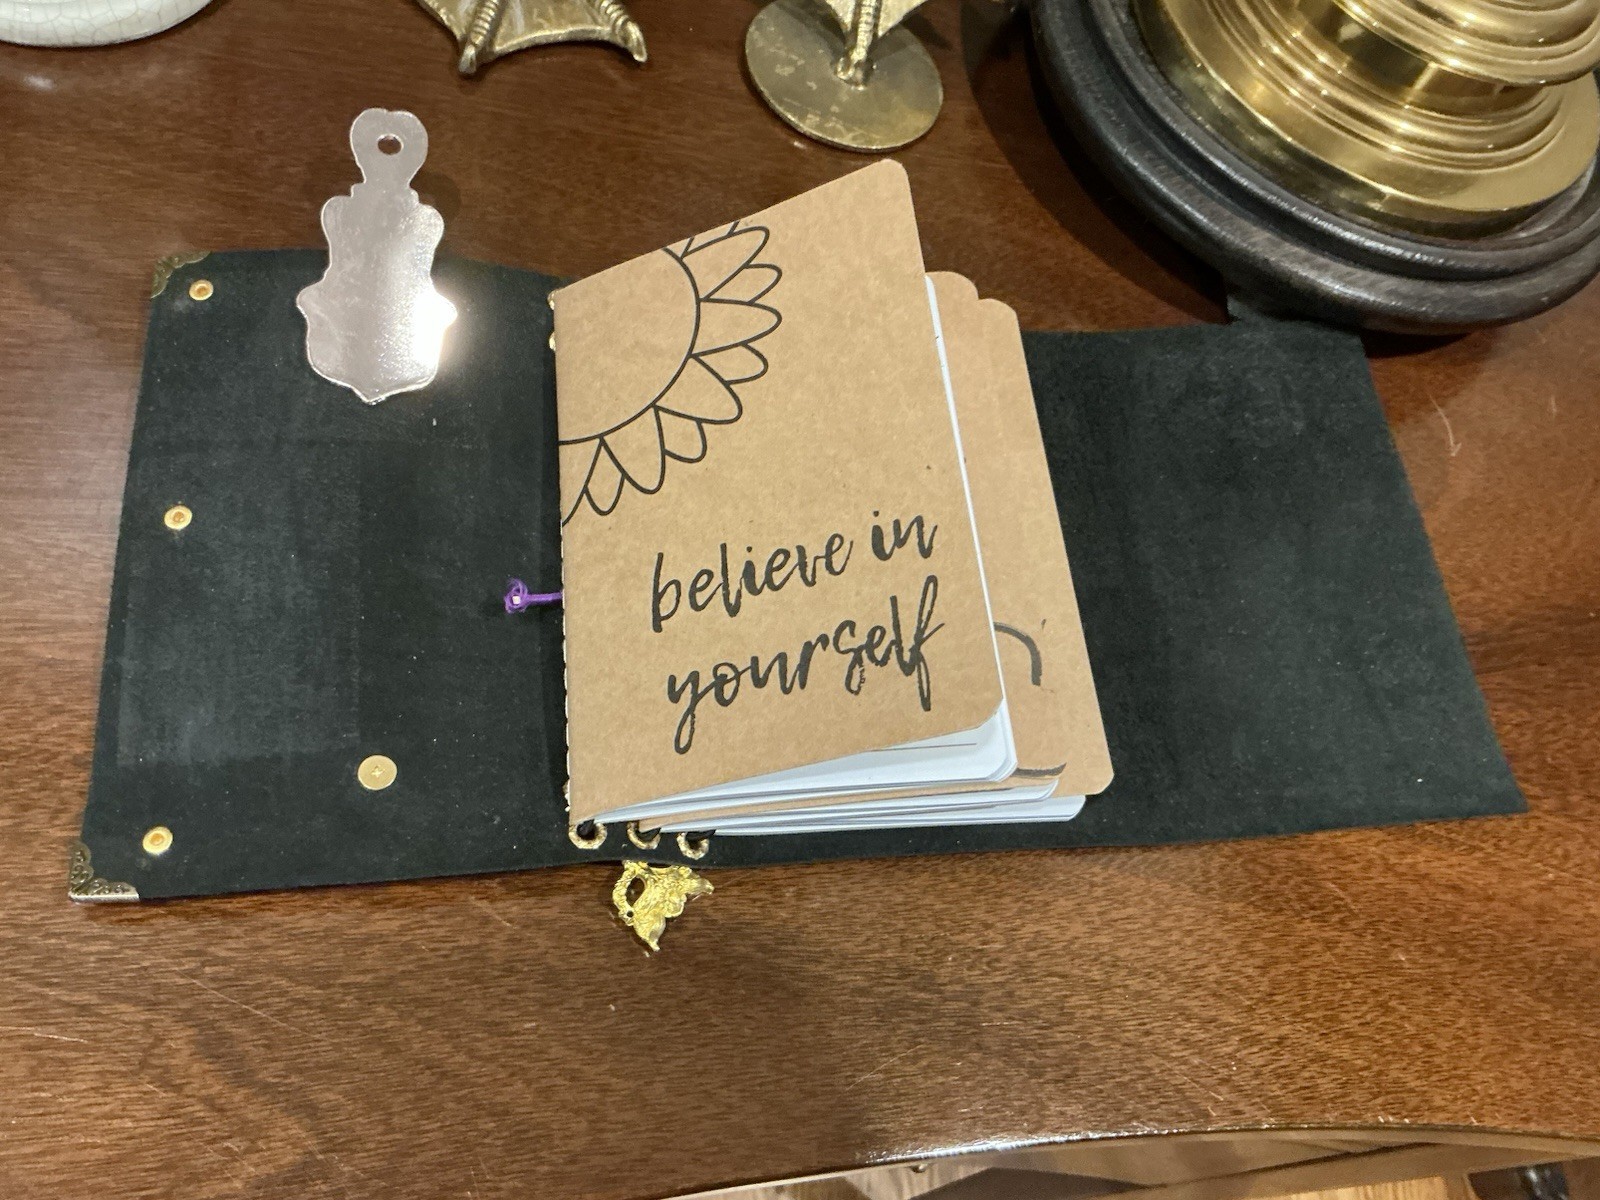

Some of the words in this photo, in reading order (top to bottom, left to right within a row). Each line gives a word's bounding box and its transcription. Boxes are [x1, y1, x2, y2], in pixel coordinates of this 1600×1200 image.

[651, 533, 854, 633] believe
[870, 510, 938, 562] in
[667, 574, 945, 755] yourself
